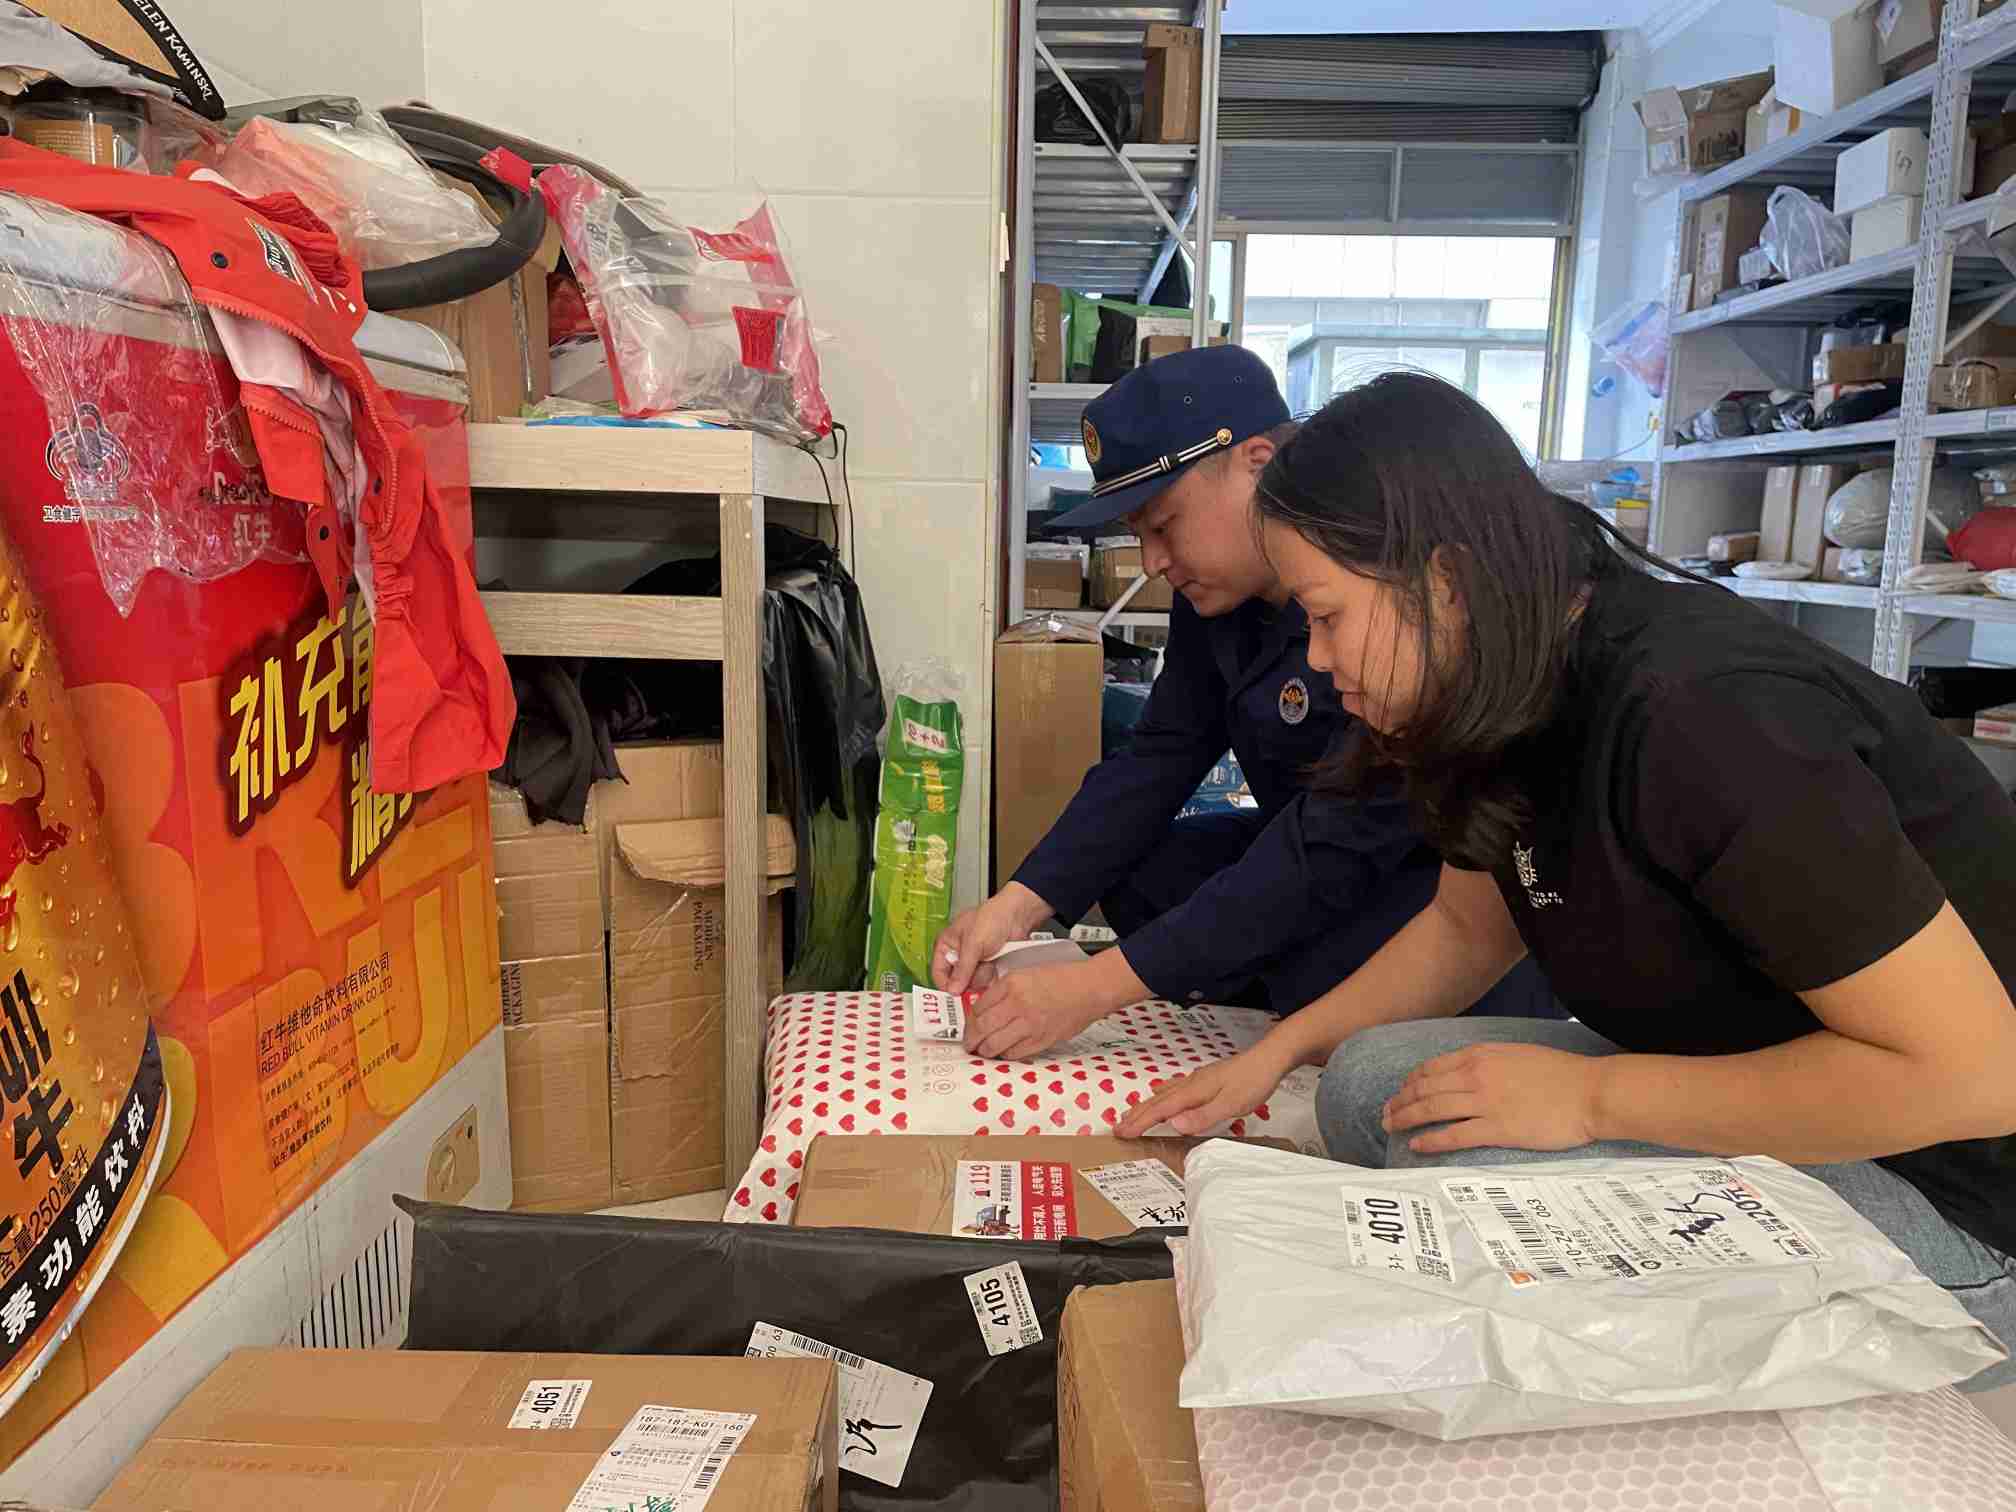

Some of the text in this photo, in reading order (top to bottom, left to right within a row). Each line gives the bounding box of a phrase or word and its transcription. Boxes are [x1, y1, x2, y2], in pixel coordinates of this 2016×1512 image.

[165, 33, 214, 102] KAMINSKI
[693, 901, 704, 971] PACKAGING
[704, 909, 713, 961] MODERN
[260, 951, 390, 1056] 红牛维他命饮料有限公司
[922, 992, 941, 1014] 119
[0, 968, 52, 1122] ull
[261, 1050, 281, 1074] RED
[282, 1037, 305, 1059] BULL
[305, 1015, 340, 1044] VITAMIN
[969, 1163, 991, 1186] 119
[0, 1092, 146, 1345] 素功能饮料
[1364, 1197, 1405, 1245] 4010
[979, 1278, 1011, 1327] 4105
[773, 1328, 784, 1341] 63
[531, 1386, 563, 1414] 4051
